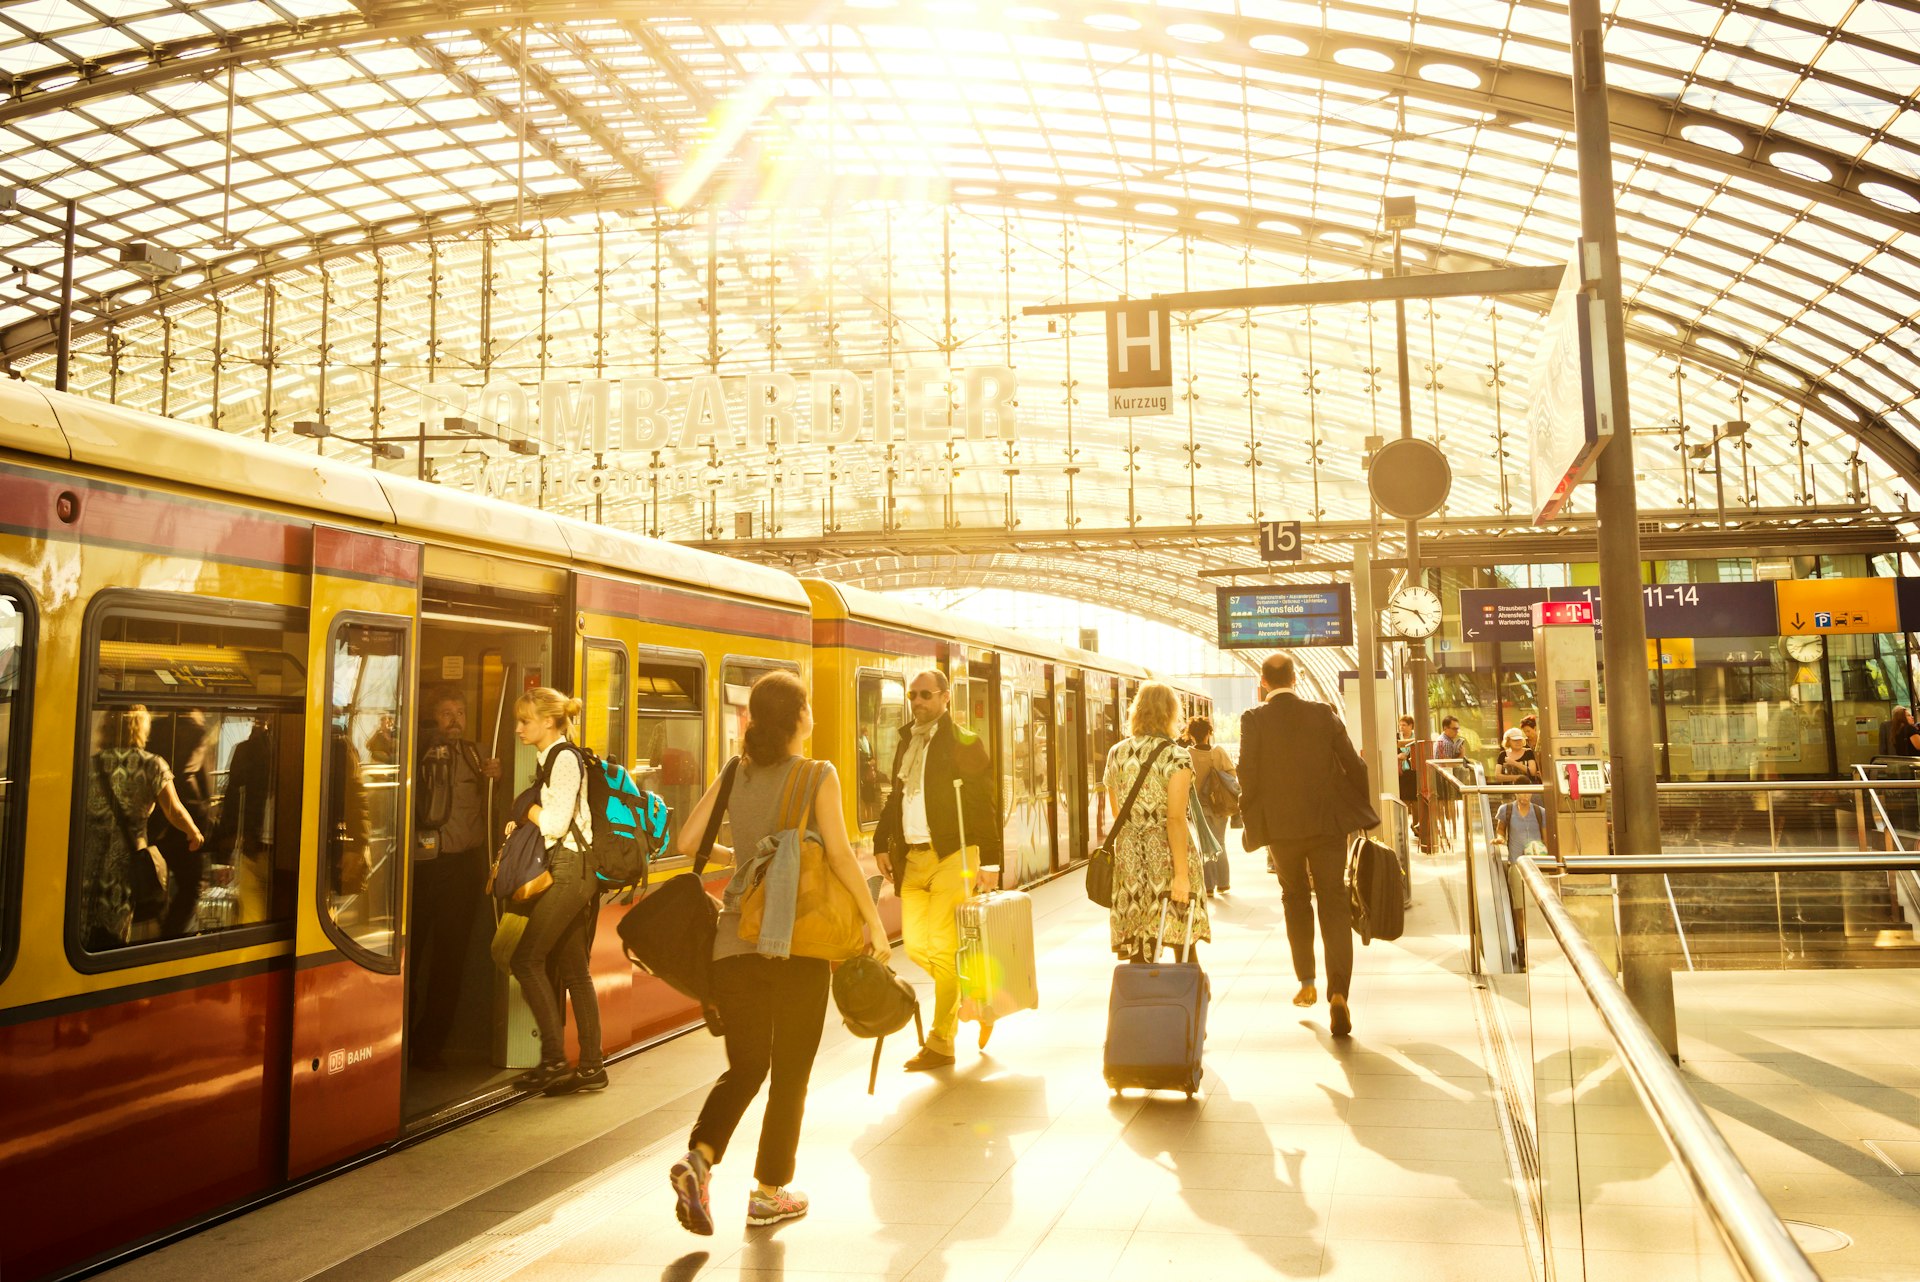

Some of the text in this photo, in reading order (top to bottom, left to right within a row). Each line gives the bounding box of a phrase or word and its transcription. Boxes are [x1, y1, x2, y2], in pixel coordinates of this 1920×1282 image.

[1116, 310, 1161, 373] H
[421, 365, 1019, 457] BOMBARDIER
[1113, 395, 1167, 411] Kurzzug
[470, 449, 954, 498] Willkommen in Berlin
[1261, 522, 1296, 552] 15
[1230, 596, 1240, 605] S7
[1643, 586, 1700, 607] 11-14
[1257, 605, 1304, 614] Ahrensfelde
[1441, 640, 1450, 651] U
[329, 1046, 373, 1073] DB BAHN
